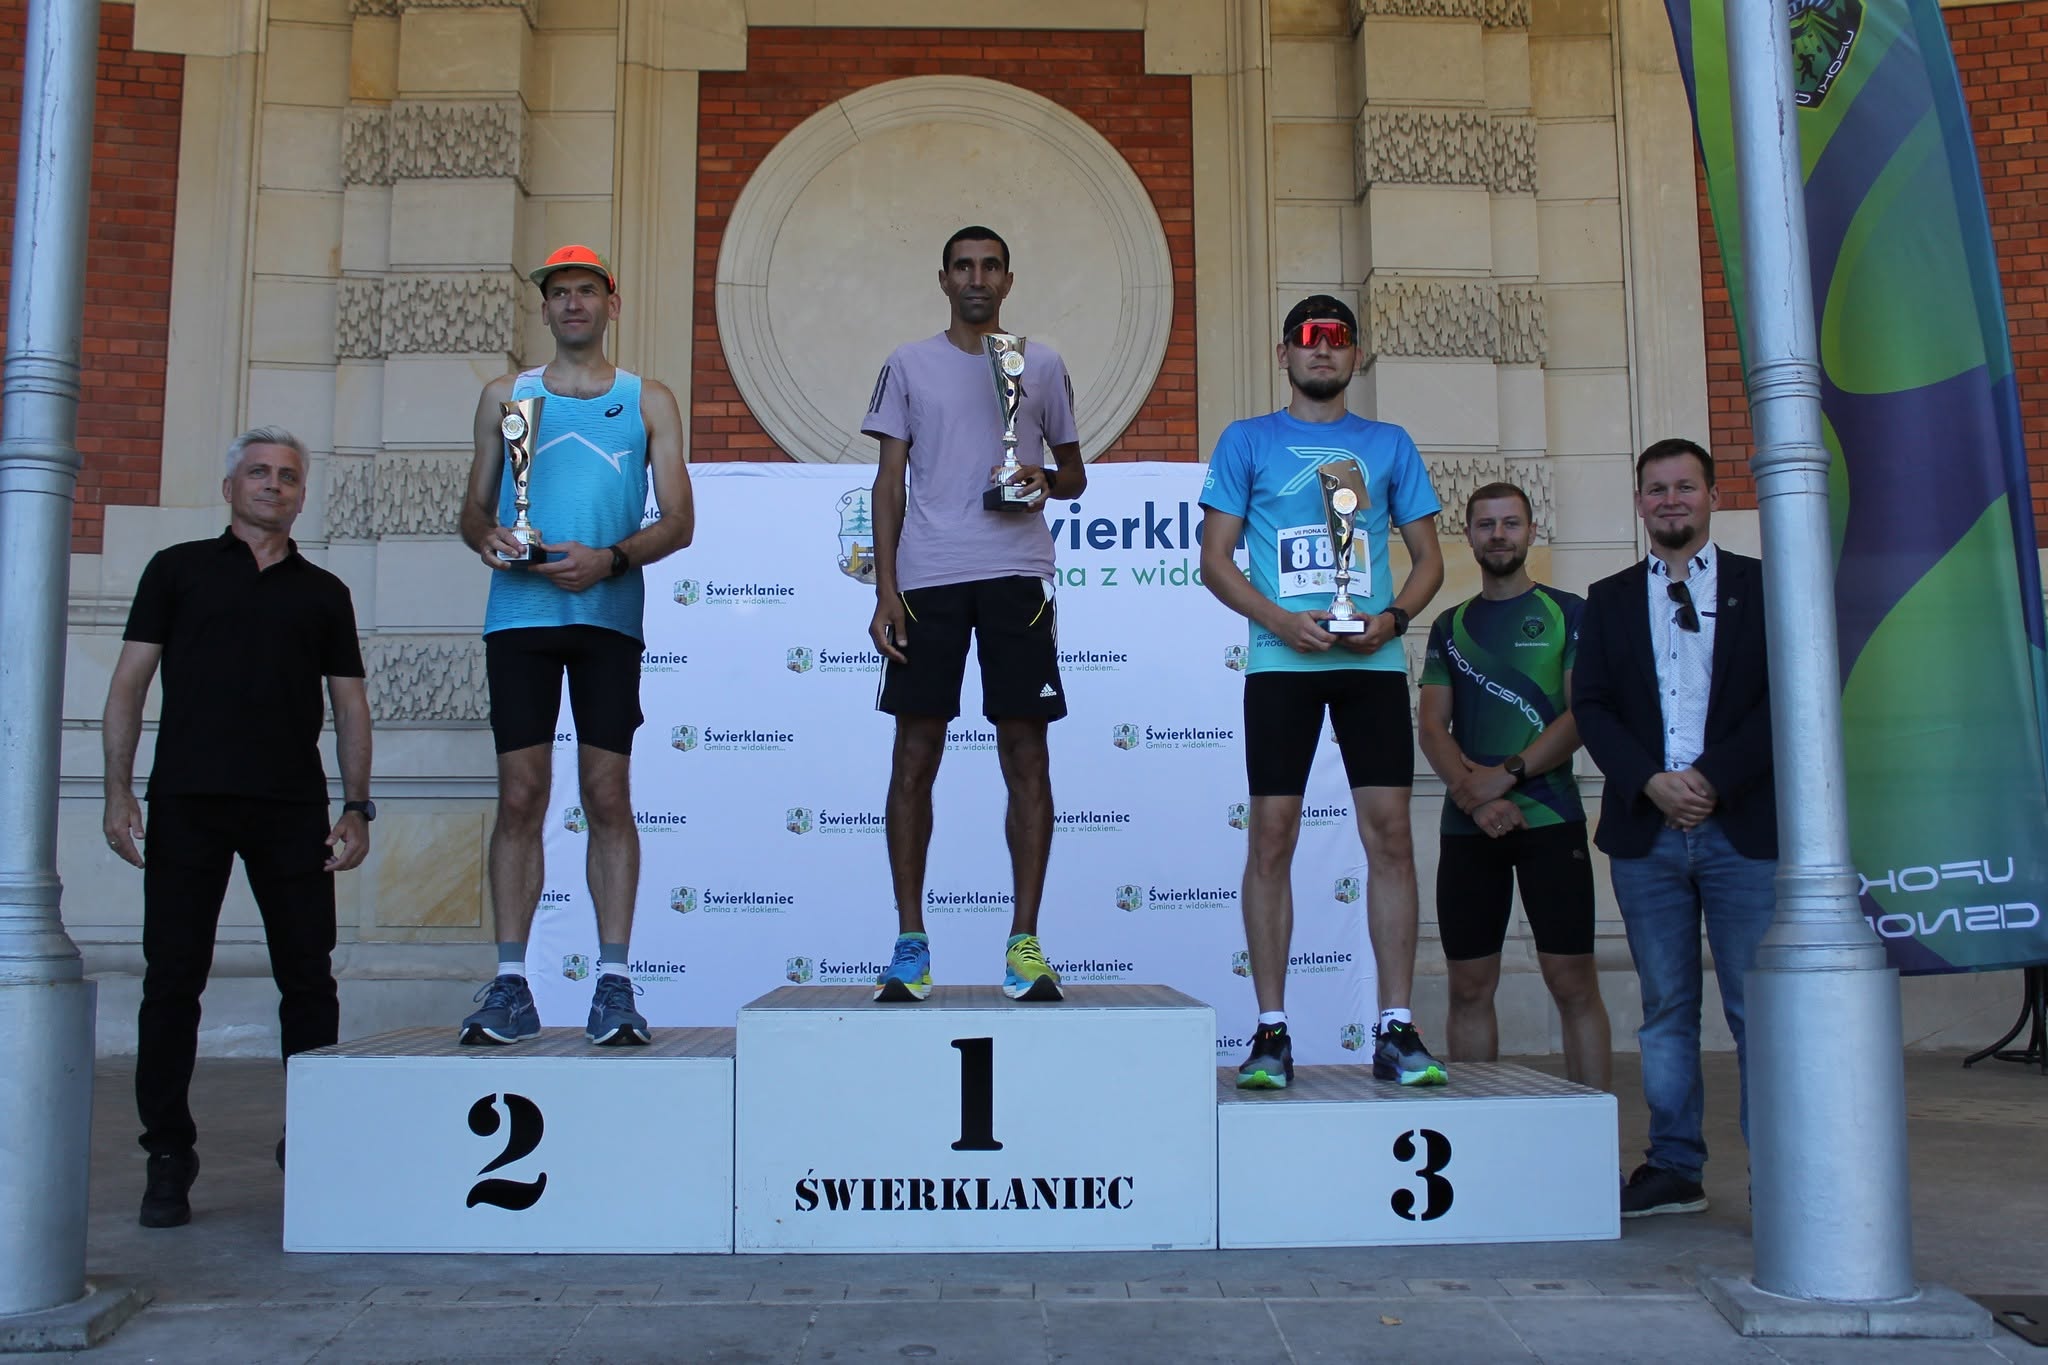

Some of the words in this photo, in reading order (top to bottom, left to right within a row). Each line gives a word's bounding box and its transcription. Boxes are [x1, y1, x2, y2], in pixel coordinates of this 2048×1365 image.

[1100, 568, 1118, 586] z
[705, 581, 795, 596] Świerklaniec
[705, 597, 733, 605] Gmina
[640, 652, 688, 664] klaniec
[1057, 650, 1128, 663] ierklaniec
[819, 664, 847, 673] Gmina
[704, 727, 794, 742] Świerklaniec
[947, 730, 995, 742] ierklan
[1145, 725, 1234, 740] Świerklaniec
[704, 743, 732, 751] Gmina
[1145, 741, 1173, 750] Gmina
[819, 825, 846, 834] Gmina
[703, 889, 794, 905] Świerklaniec
[1148, 887, 1237, 901] Świerklaniec
[703, 905, 731, 914] Gmina
[926, 905, 955, 914] Gmina
[1148, 902, 1176, 911] Gmina
[1288, 951, 1352, 966] erklaniec
[819, 974, 847, 983] Gmina
[950, 1037, 1004, 1151] 1
[466, 1093, 547, 1211] 2
[1390, 1129, 1454, 1221] 3
[795, 1169, 1135, 1211] ŚWIERKLANIEC
